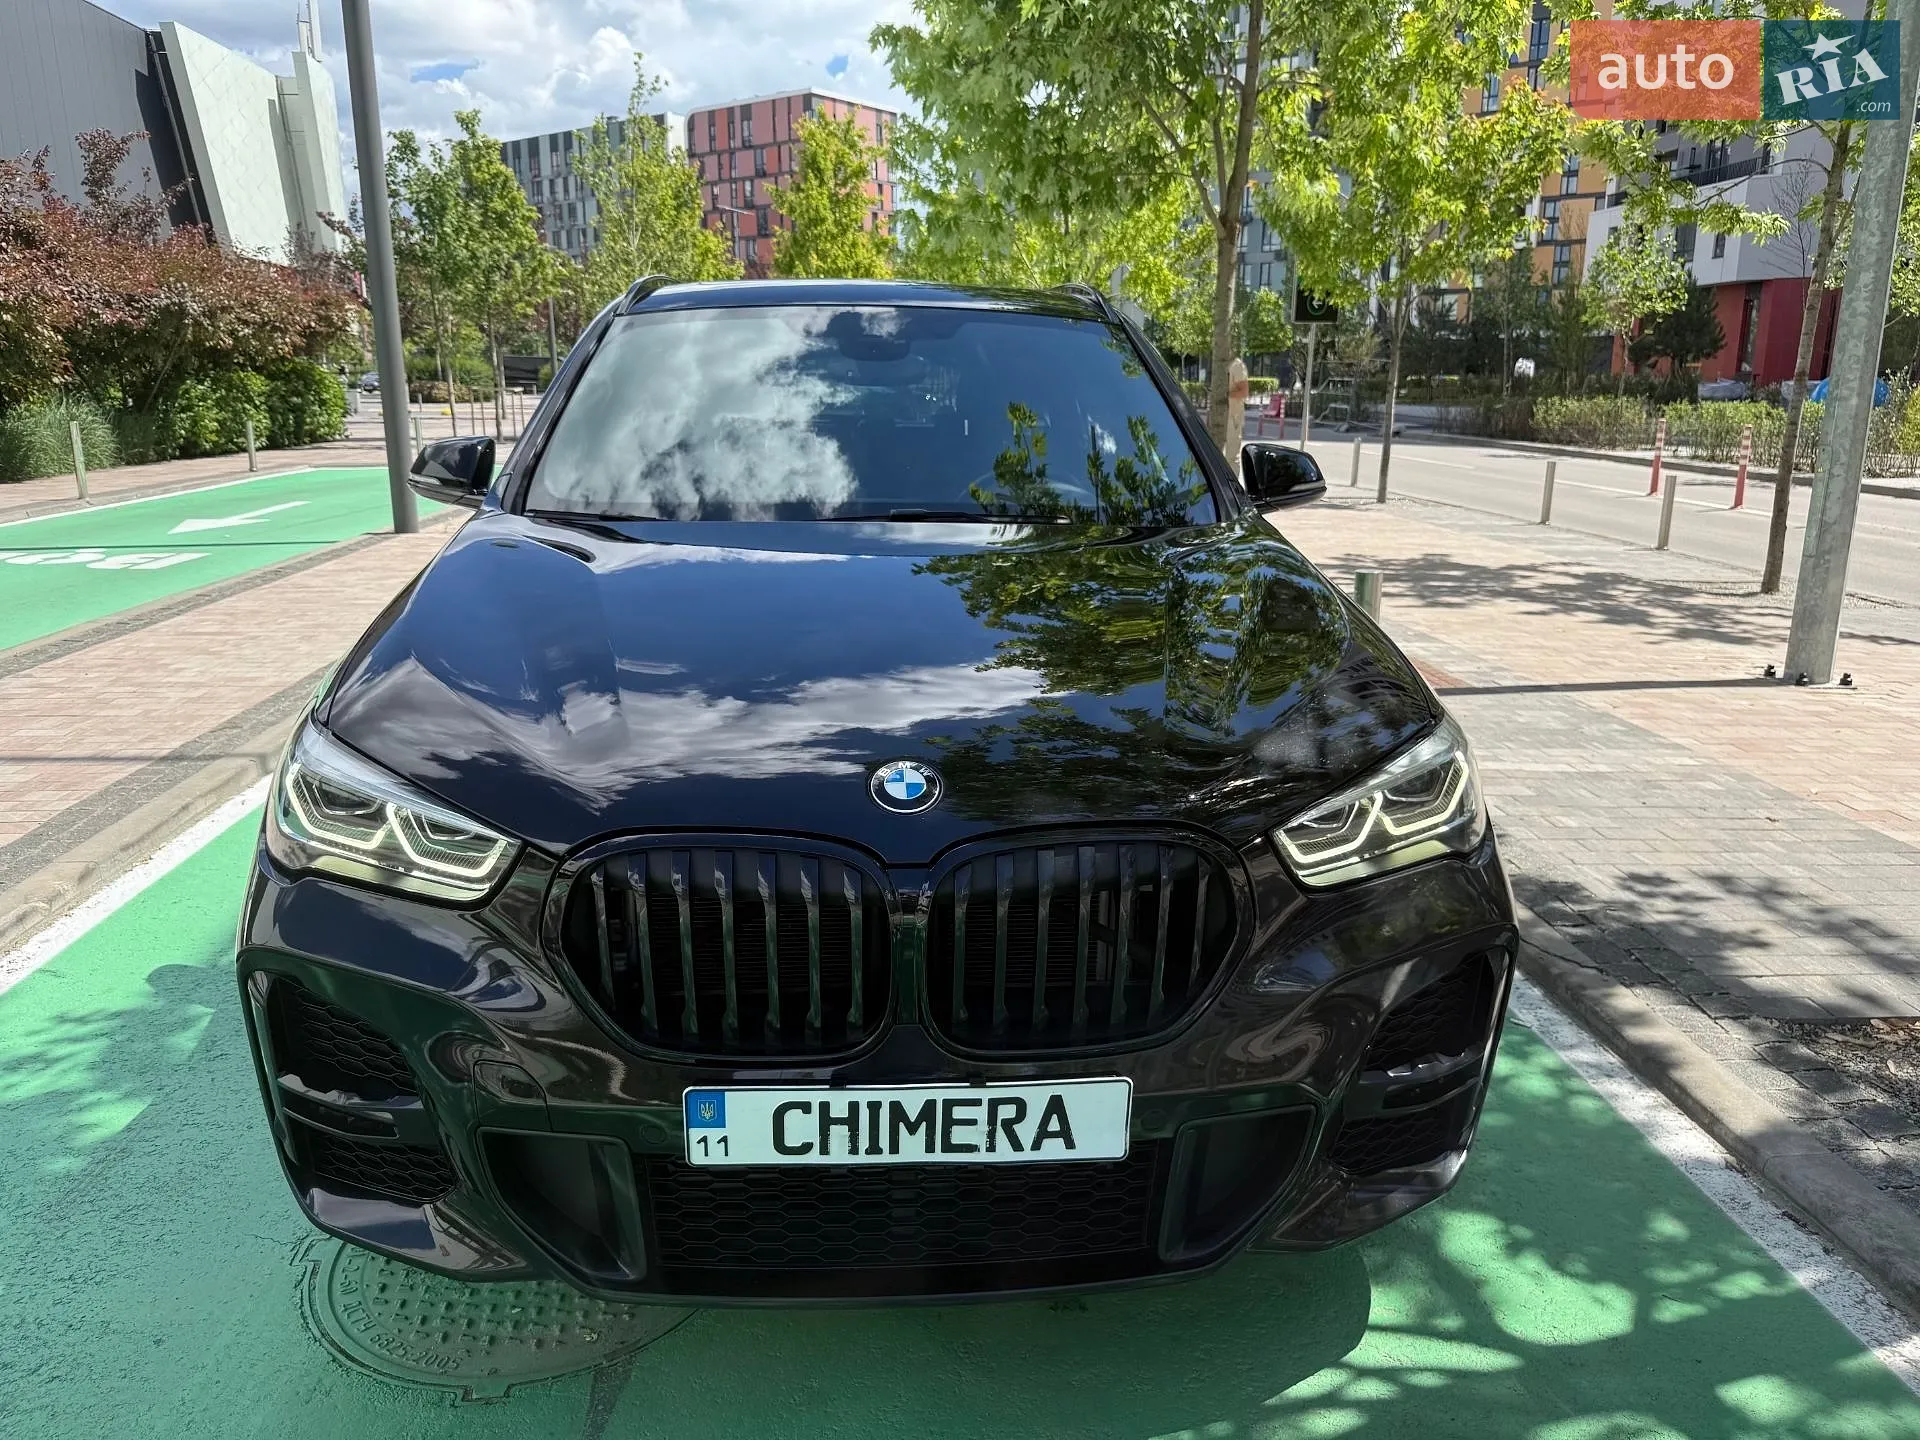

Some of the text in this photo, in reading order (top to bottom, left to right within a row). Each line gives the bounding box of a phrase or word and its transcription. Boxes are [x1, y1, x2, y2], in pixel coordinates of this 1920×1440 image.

[878, 760, 934, 778] BMW
[772, 1094, 1077, 1156] CHIMERA
[696, 1134, 730, 1157] 11
